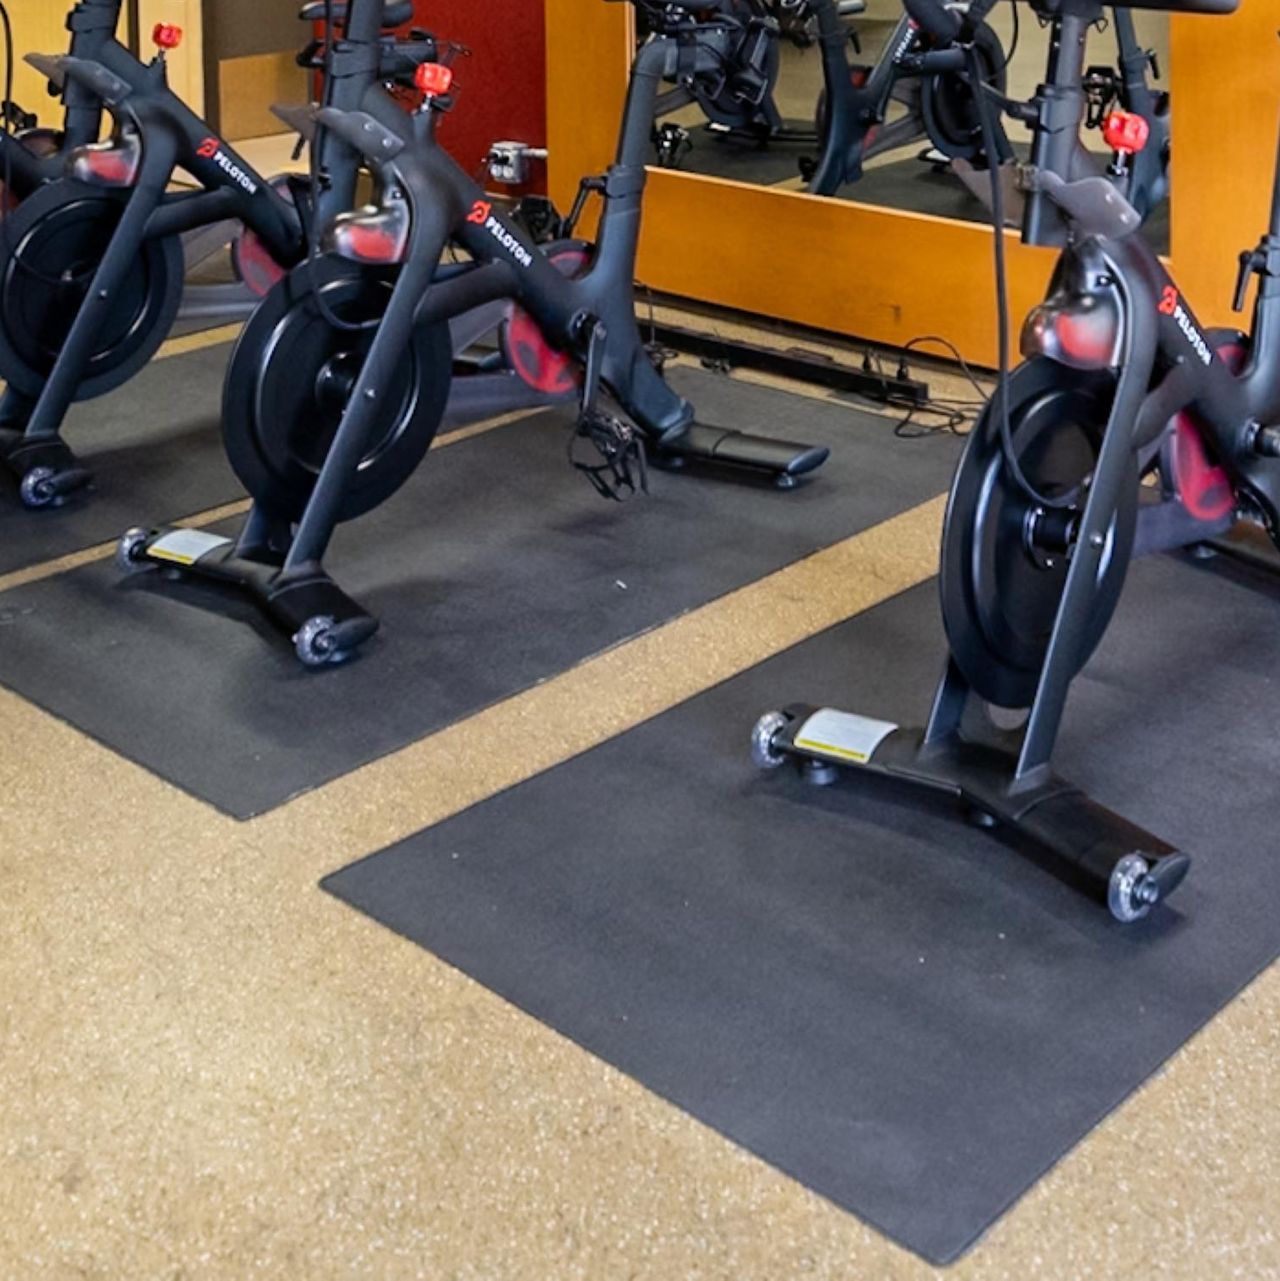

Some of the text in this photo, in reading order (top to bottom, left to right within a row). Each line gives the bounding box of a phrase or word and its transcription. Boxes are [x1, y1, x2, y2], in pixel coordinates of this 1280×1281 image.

[213, 151, 257, 194] PELOTON
[485, 215, 533, 266] PELOTON
[1174, 305, 1212, 366] PELOTON
